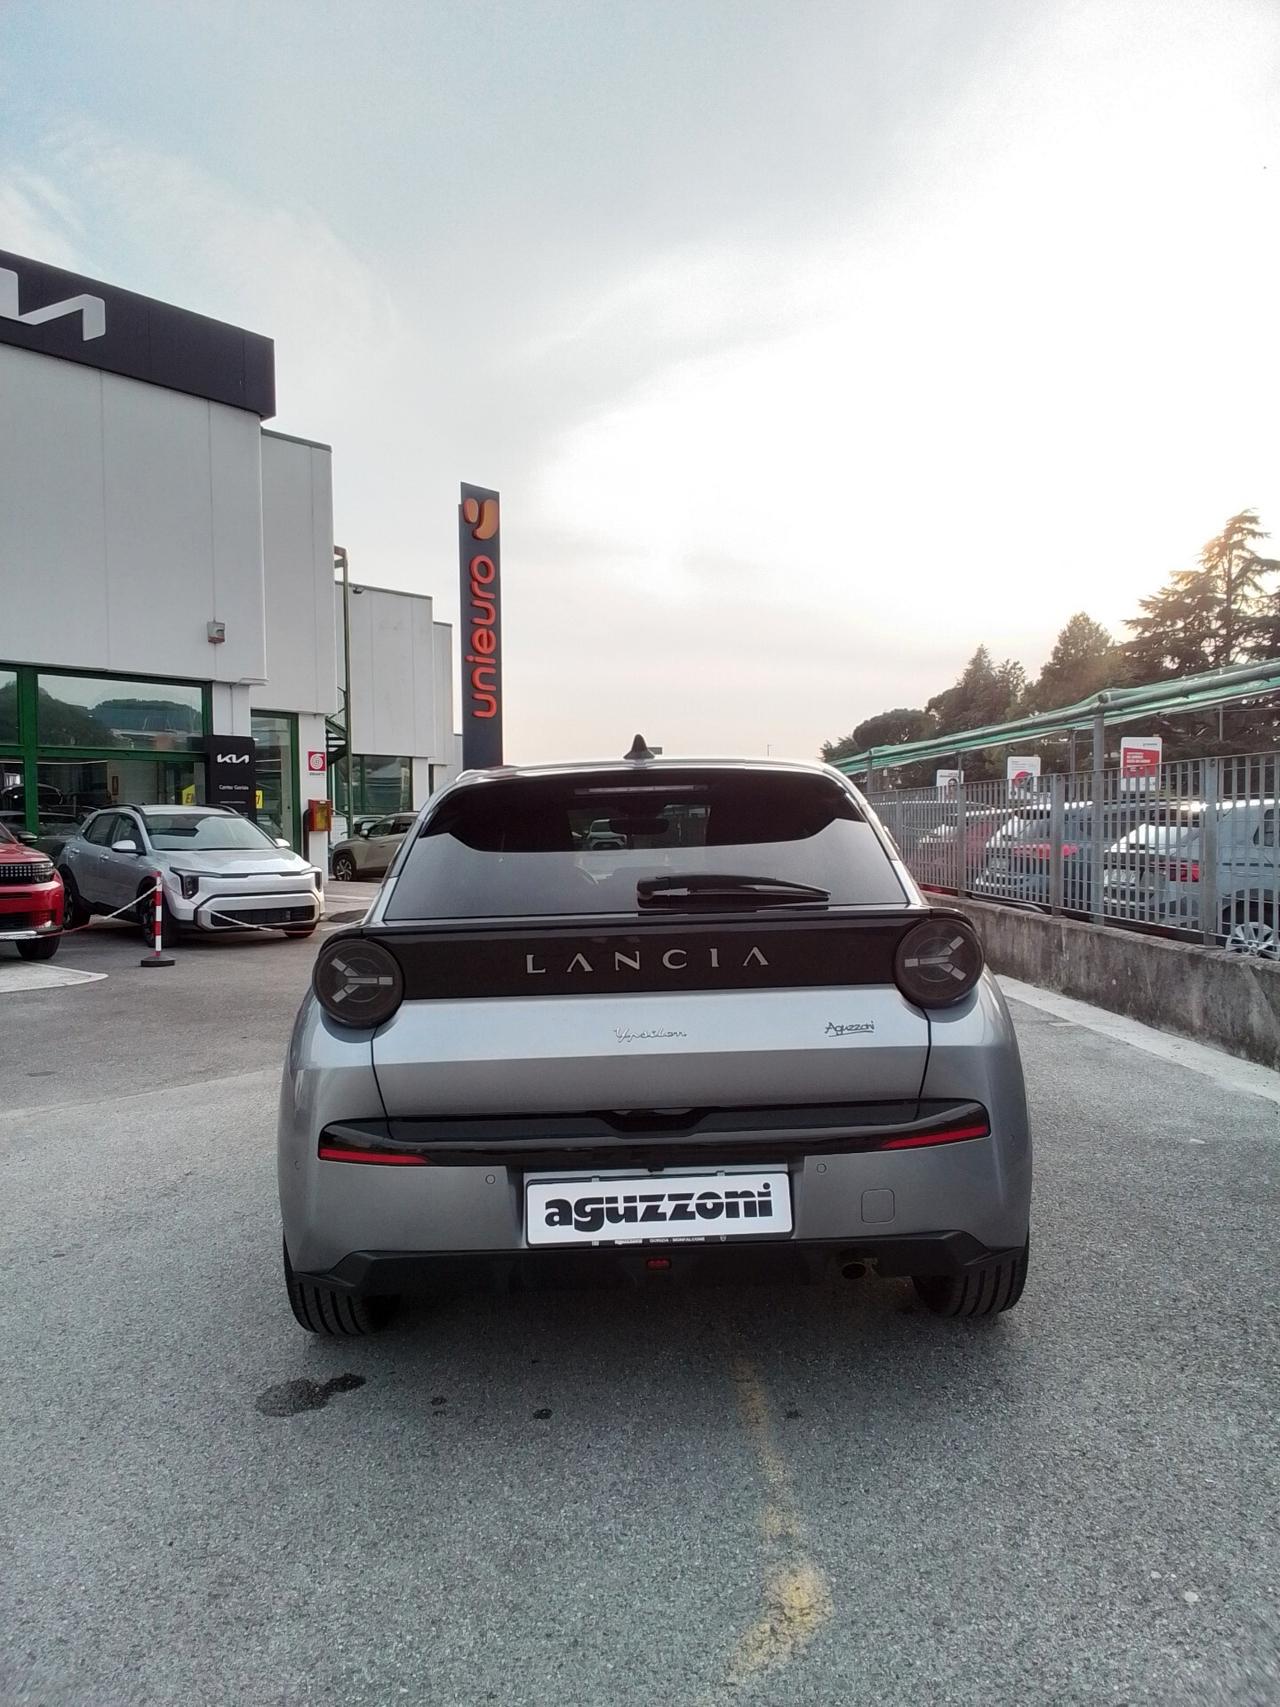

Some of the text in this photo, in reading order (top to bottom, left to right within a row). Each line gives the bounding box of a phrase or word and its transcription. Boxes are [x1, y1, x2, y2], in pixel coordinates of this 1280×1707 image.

[466, 555, 497, 718] unieuro
[525, 946, 770, 974] LANCIA
[544, 1182, 773, 1233] aguzzoni
